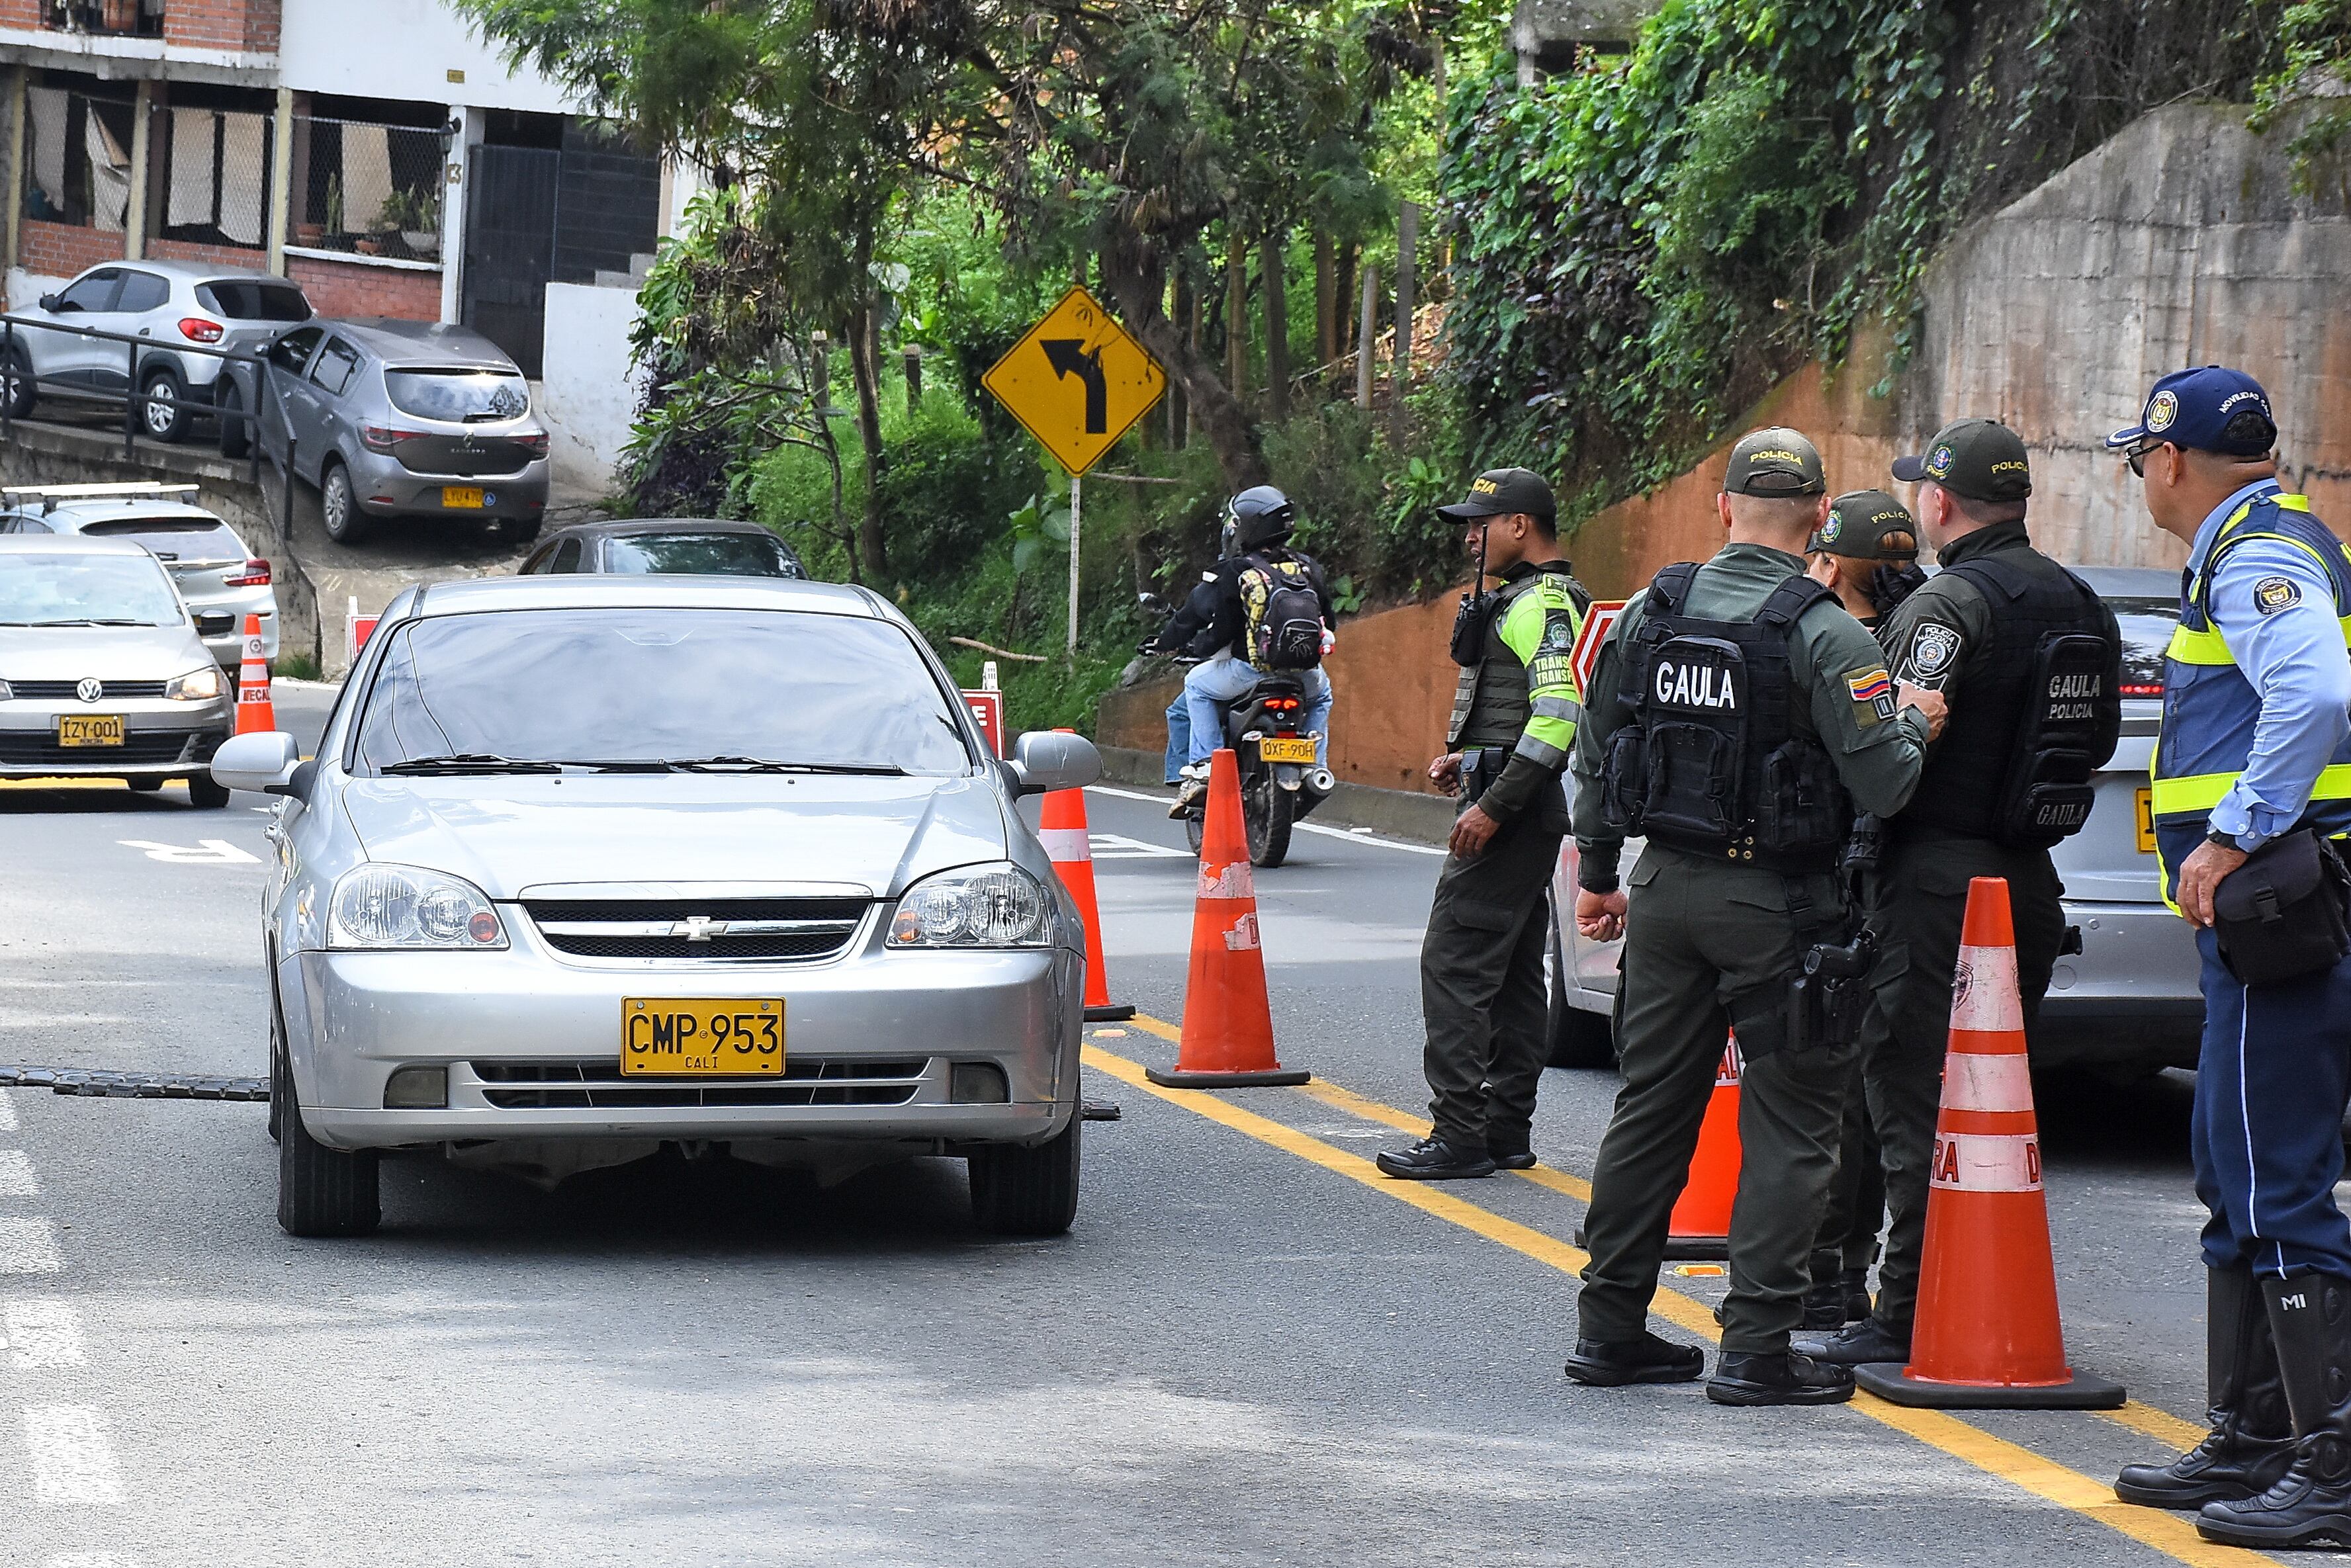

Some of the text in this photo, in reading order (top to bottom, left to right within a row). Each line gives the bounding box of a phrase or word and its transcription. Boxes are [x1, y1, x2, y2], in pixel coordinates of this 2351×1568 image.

[1750, 450, 1802, 466] POLICIA
[1656, 662, 1735, 709] GAULA
[2049, 675, 2100, 698] GAULA
[2048, 703, 2093, 719] POLICIA
[2037, 804, 2086, 825] GAULA
[685, 1056, 718, 1068] CALI
[2280, 1293, 2307, 1311] MI
